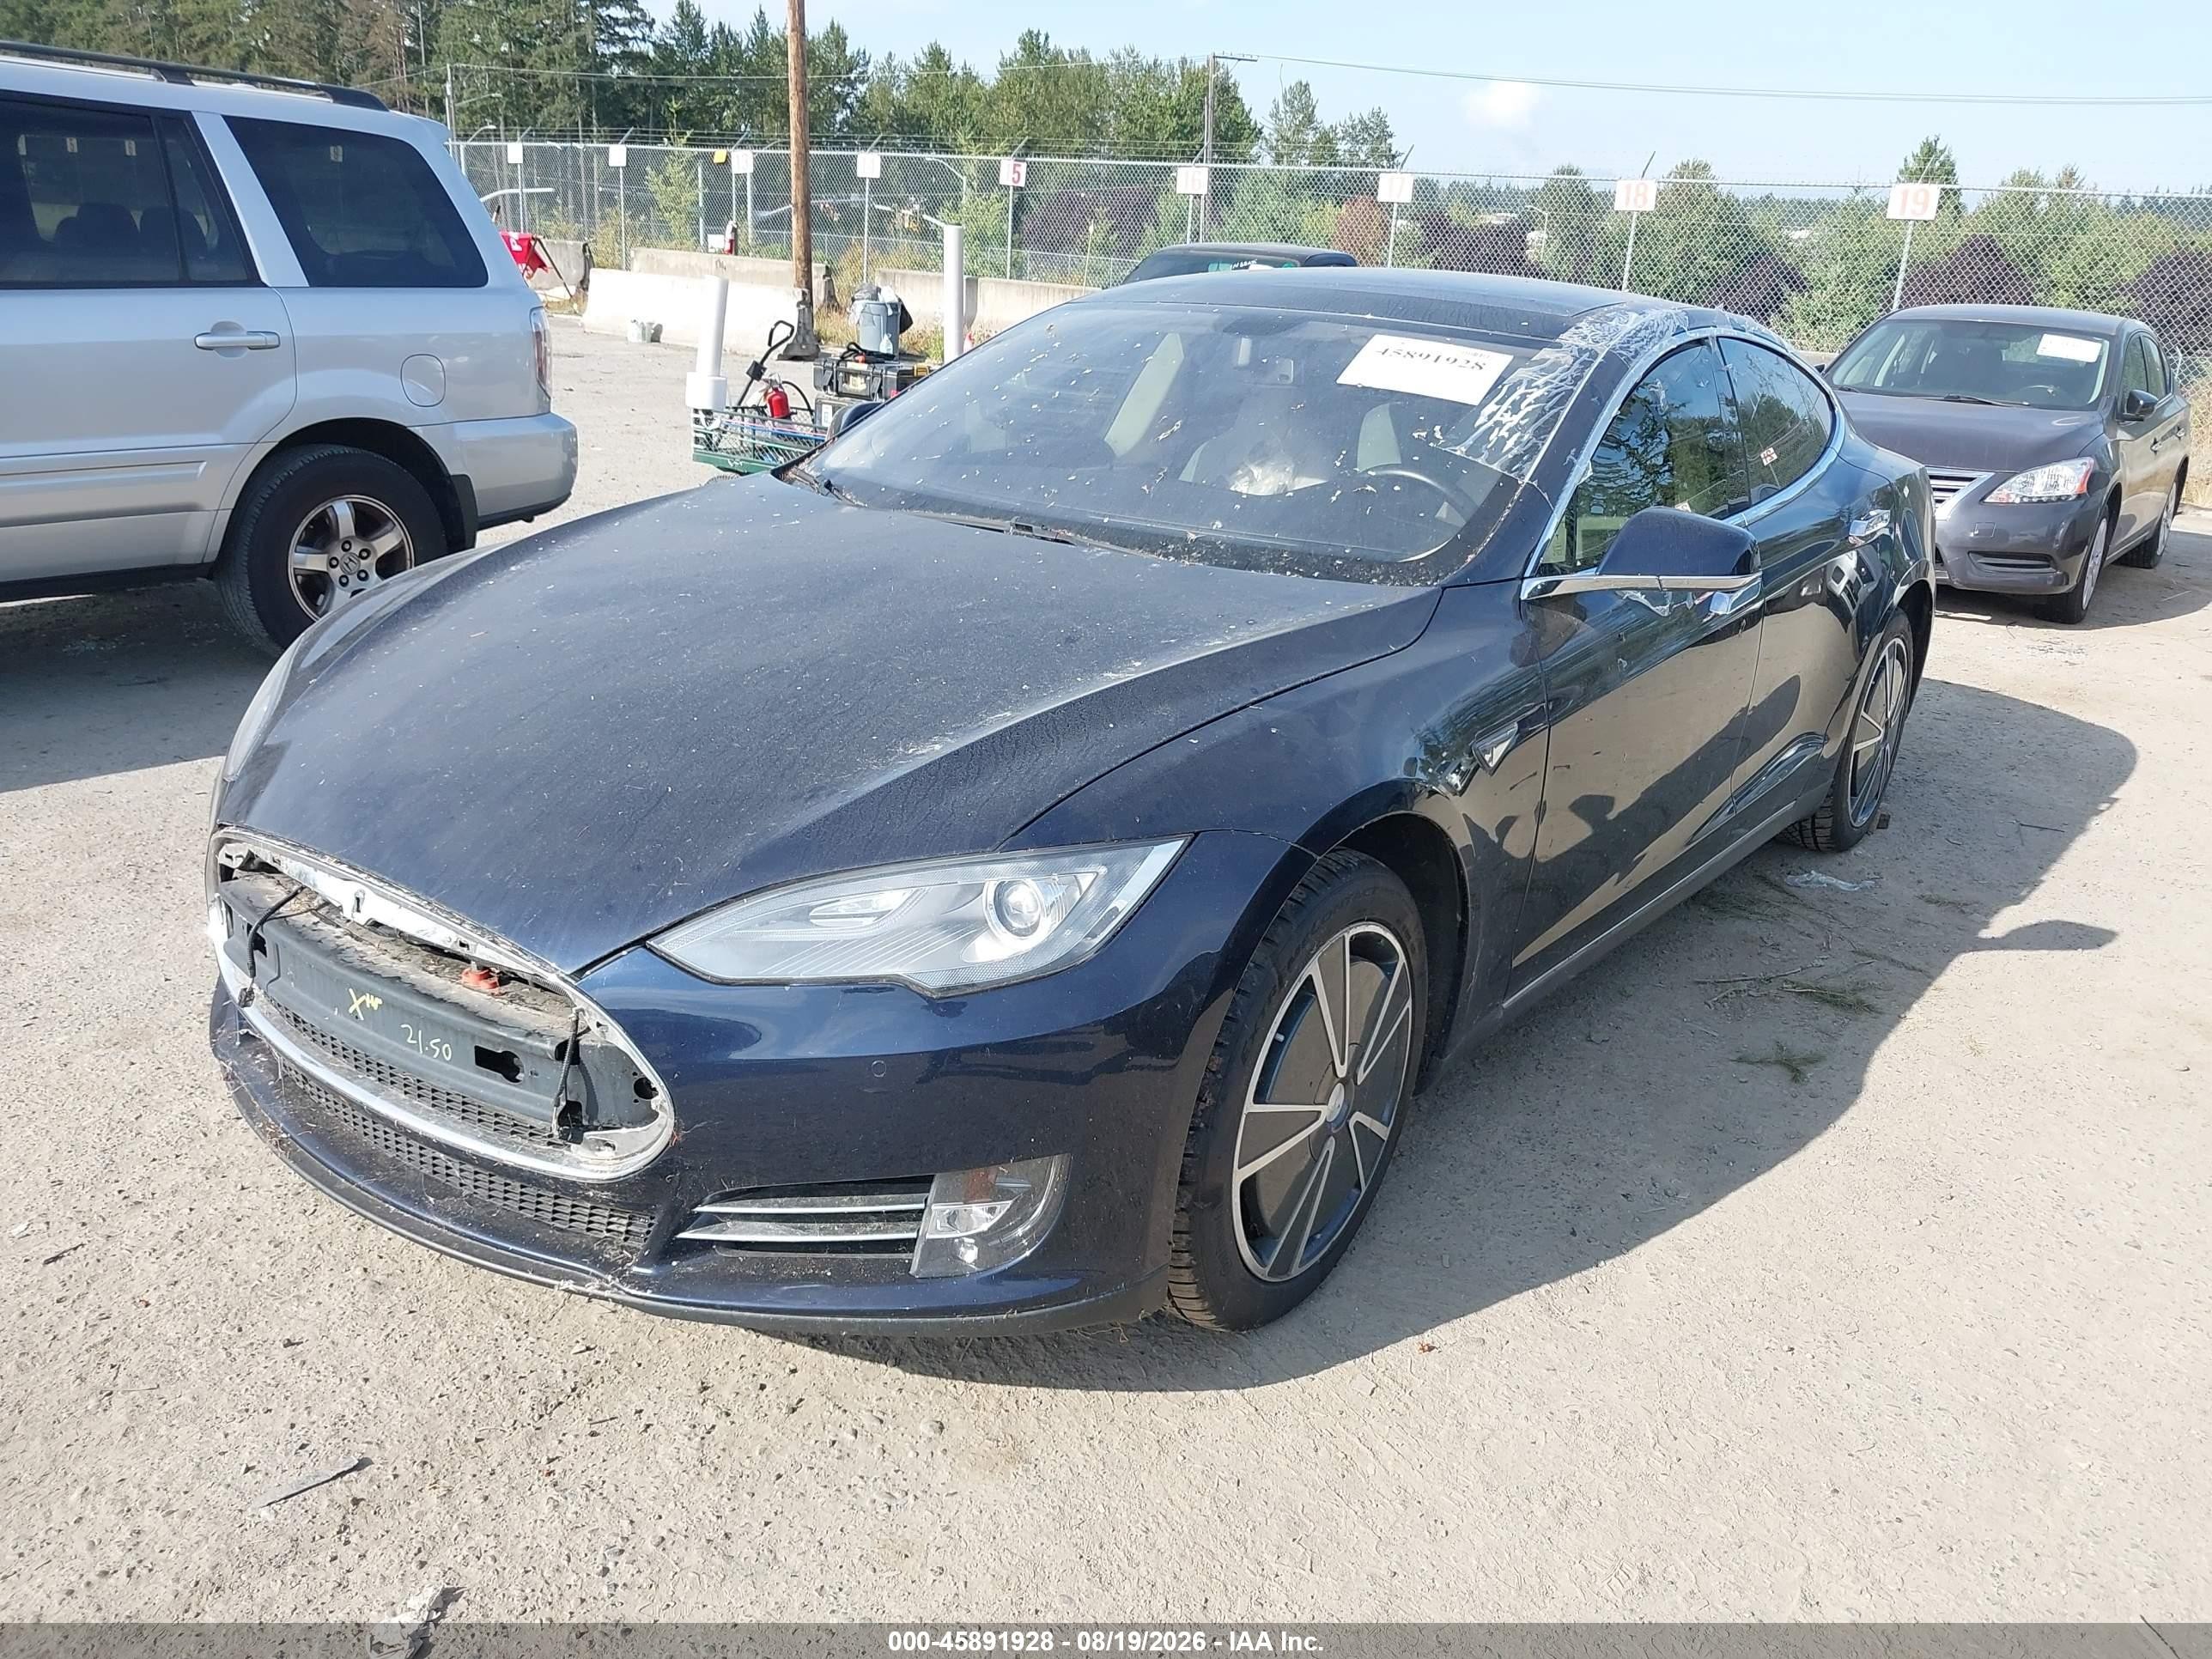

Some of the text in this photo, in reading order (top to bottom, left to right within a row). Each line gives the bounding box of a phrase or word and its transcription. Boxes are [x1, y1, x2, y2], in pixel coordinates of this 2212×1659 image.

[1183, 170, 1201, 191] 16
[1388, 177, 1407, 200] 17
[1625, 182, 1649, 209] 18
[1899, 187, 1929, 215] 19
[1375, 347, 1487, 371] 45891928
[400, 1024, 452, 1061] 21.50
